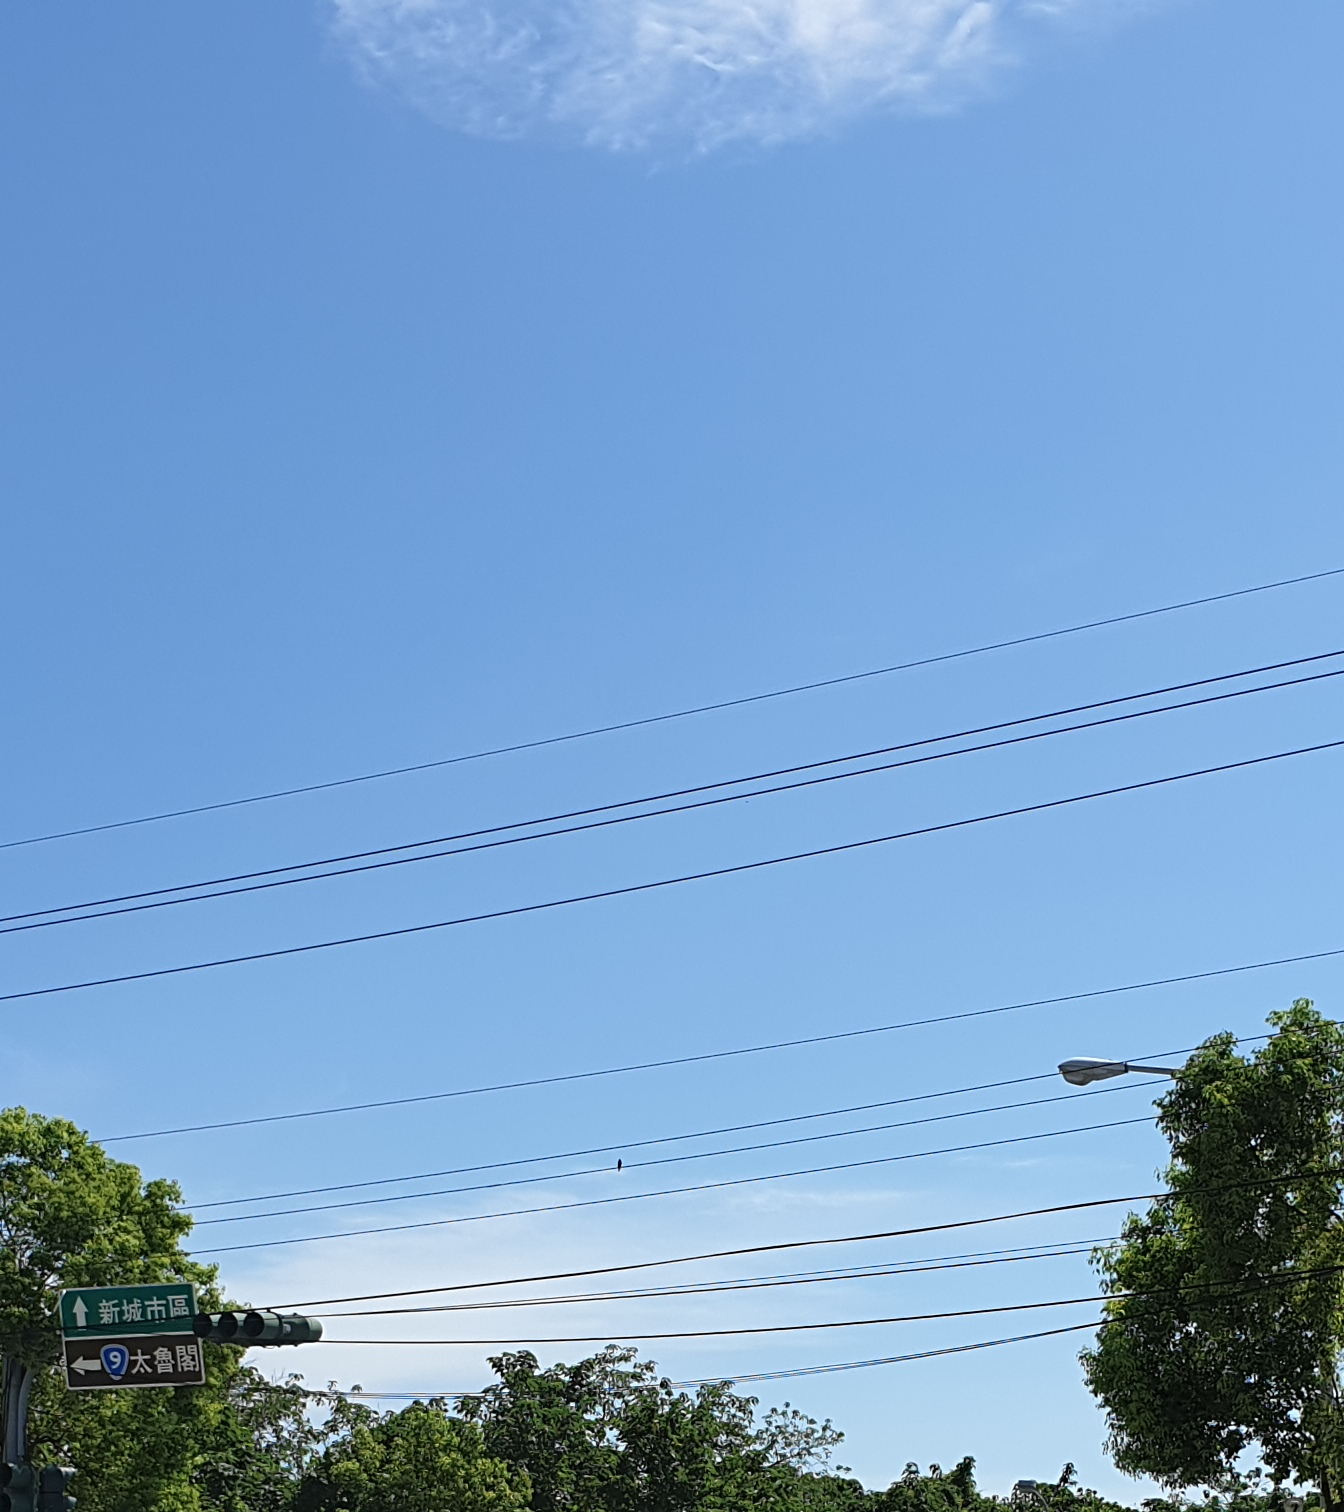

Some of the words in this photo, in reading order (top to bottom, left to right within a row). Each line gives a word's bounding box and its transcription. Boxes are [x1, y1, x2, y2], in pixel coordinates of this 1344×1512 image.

[99, 1295, 189, 1324] 新城市區
[109, 1350, 121, 1369] 9
[129, 1344, 200, 1375] 太魯閣
